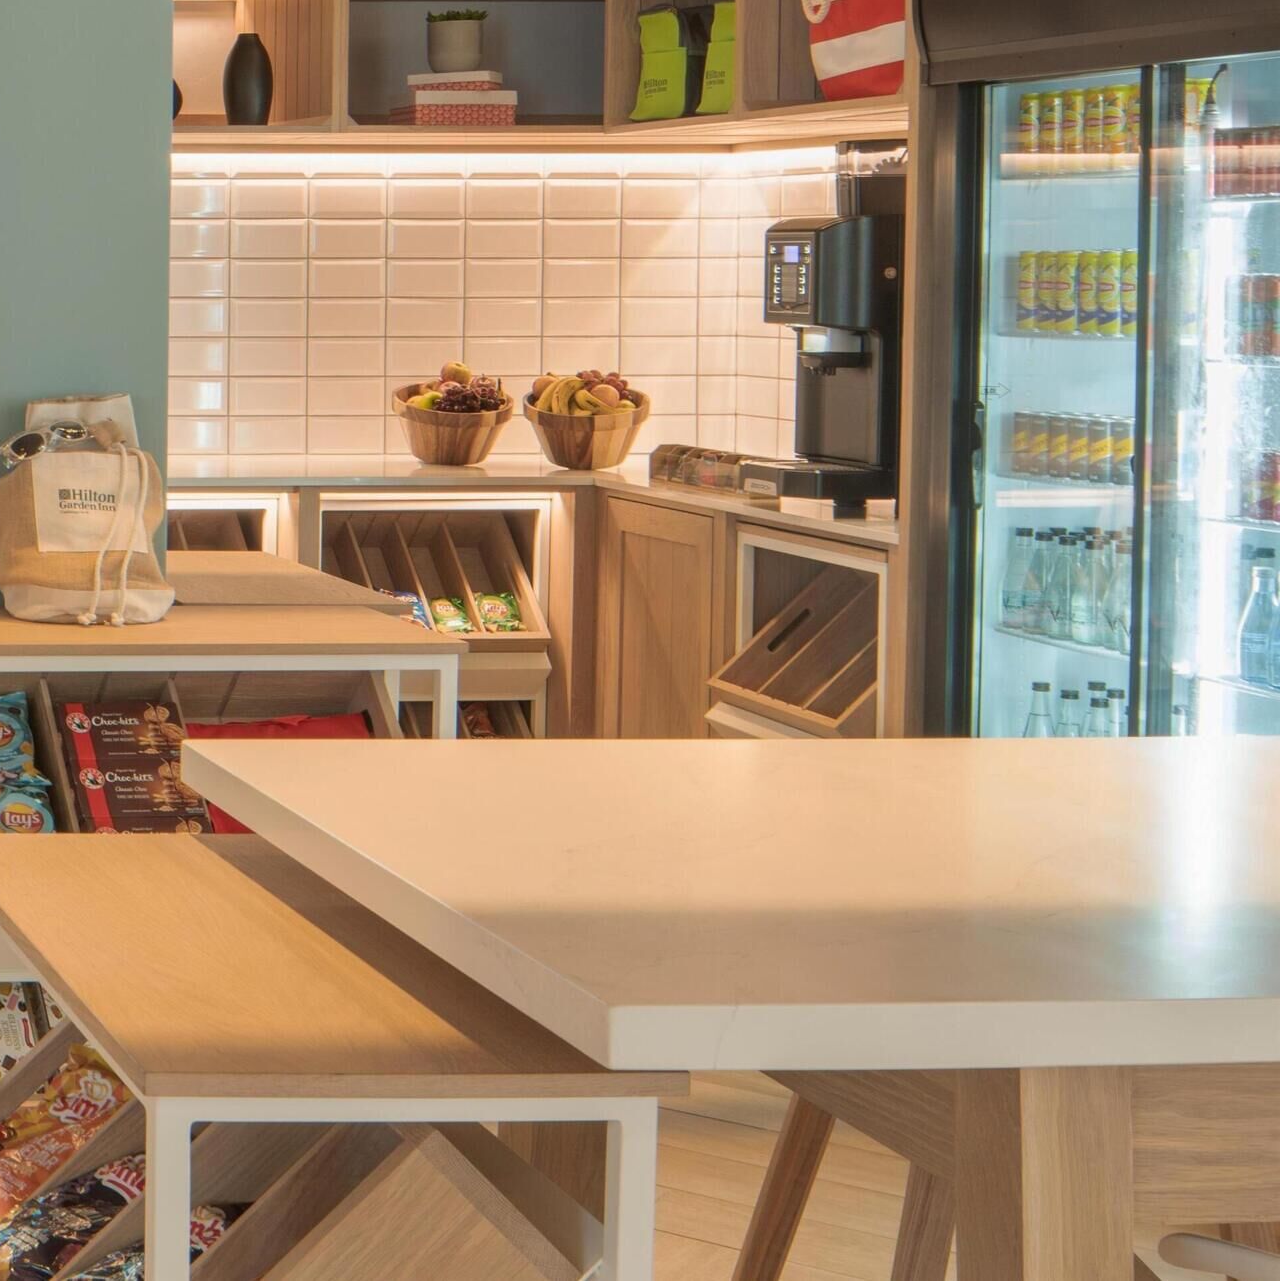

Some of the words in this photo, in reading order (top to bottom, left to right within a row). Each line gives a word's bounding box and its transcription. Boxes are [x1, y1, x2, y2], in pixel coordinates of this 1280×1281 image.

[72, 488, 116, 504] Hilton
[59, 501, 97, 510] Garden
[98, 502, 117, 512] Inn
[4, 811, 41, 828] Lay's
